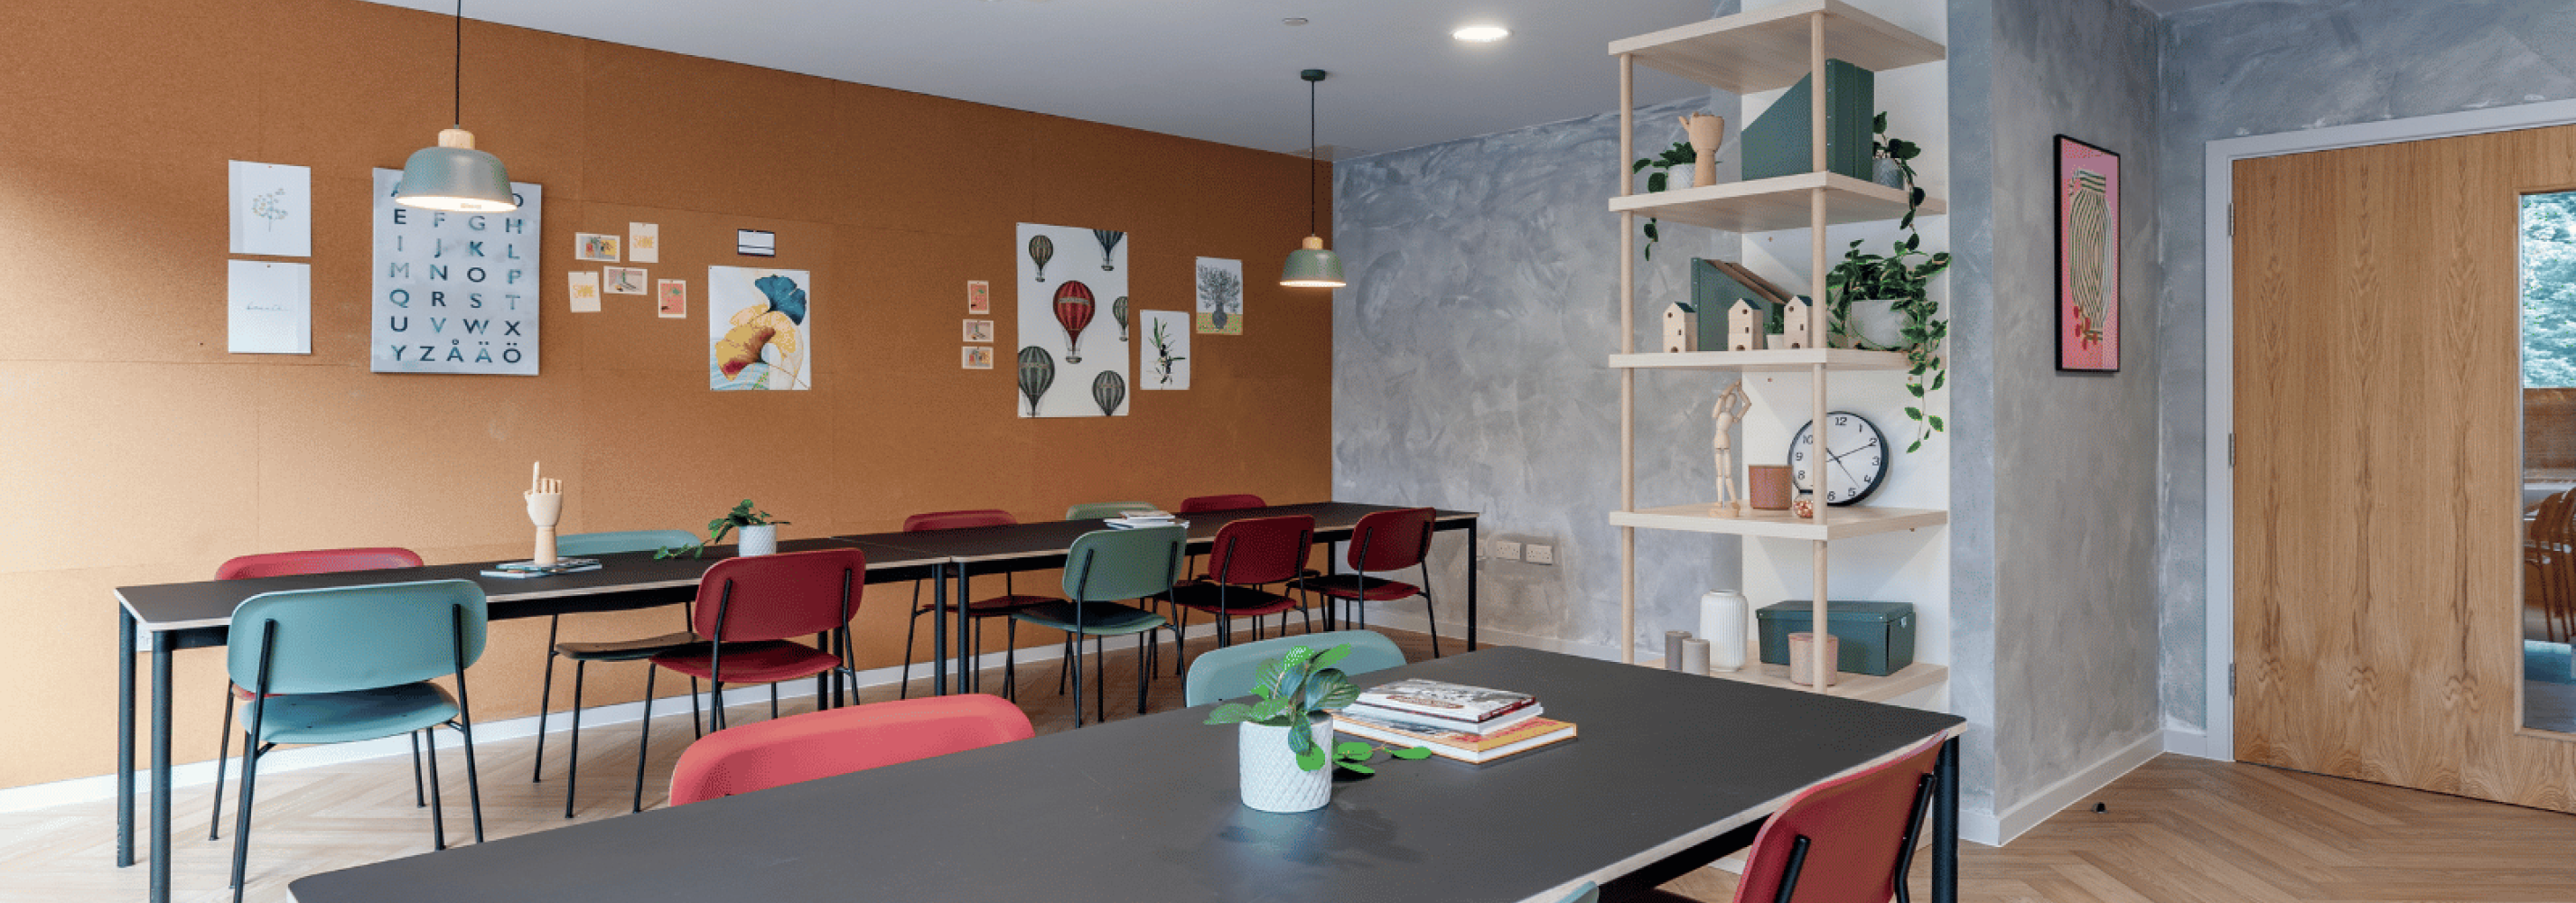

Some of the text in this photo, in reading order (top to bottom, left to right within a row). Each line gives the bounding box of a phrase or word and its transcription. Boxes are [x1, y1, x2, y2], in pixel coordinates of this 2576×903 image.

[394, 209, 522, 234] E F G H
[397, 235, 520, 259] I J K L
[390, 262, 522, 284] M N O P
[389, 288, 521, 311] Q R S T
[390, 316, 521, 337] U V W X
[390, 339, 521, 364] Y Z Å Ä Ö
[1834, 416, 1847, 426] 12
[1859, 423, 1863, 433] 1
[1802, 434, 1813, 444] 10
[1869, 437, 1878, 446] 2
[1795, 452, 1804, 461] 9
[1871, 455, 1880, 466] 3
[1797, 470, 1806, 480] 8
[1863, 474, 1871, 483] 4
[1827, 490, 1835, 501] 6
[1847, 488, 1856, 498] 5
